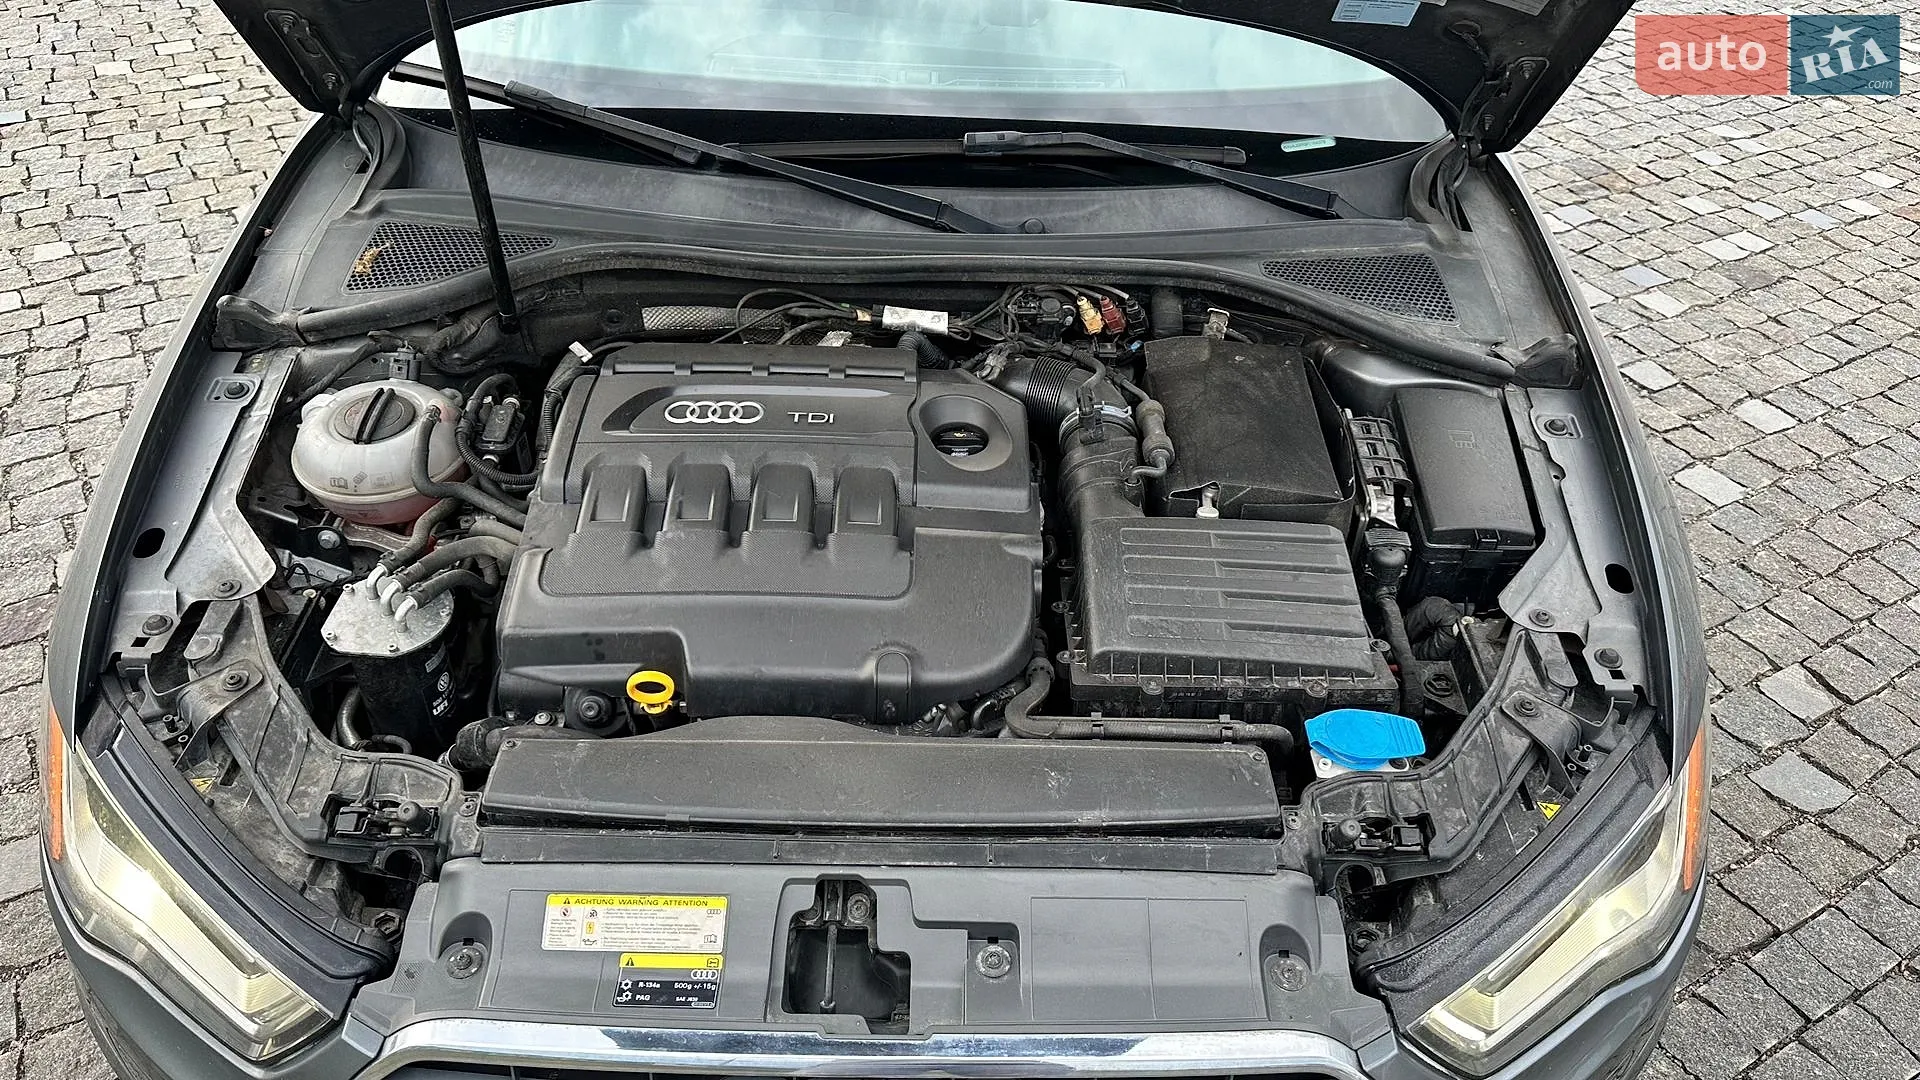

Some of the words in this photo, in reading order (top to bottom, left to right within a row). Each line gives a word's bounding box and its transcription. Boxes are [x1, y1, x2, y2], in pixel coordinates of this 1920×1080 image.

[787, 411, 834, 424] TDI
[574, 898, 614, 906] ACHTUNG
[618, 899, 659, 907] WARNING
[638, 981, 661, 989] R-134a
[674, 982, 692, 990] 500g
